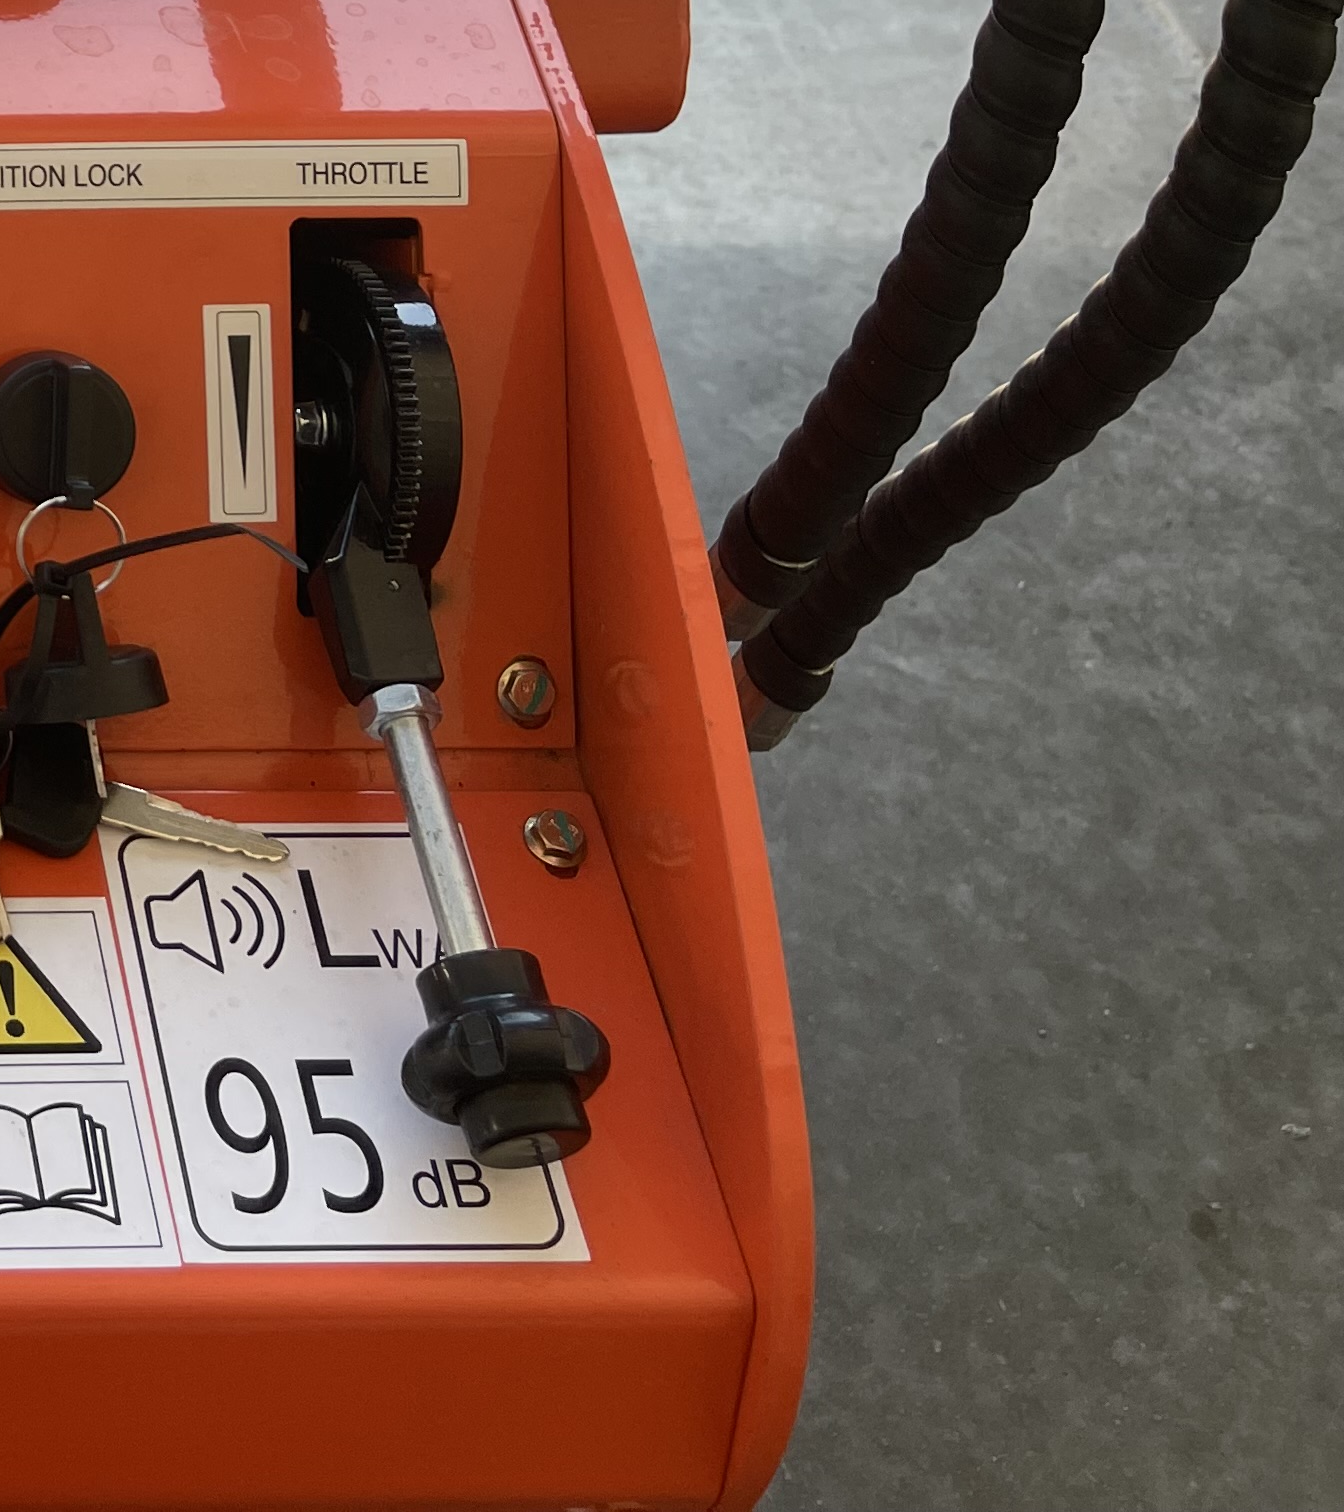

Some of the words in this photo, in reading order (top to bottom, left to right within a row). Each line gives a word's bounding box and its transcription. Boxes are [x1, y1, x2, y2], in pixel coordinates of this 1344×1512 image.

[73, 163, 144, 188] LOCK
[295, 161, 430, 186] THROTTLE
[297, 869, 445, 969] LW
[204, 1056, 385, 1215] 95
[411, 1158, 493, 1209] dB
